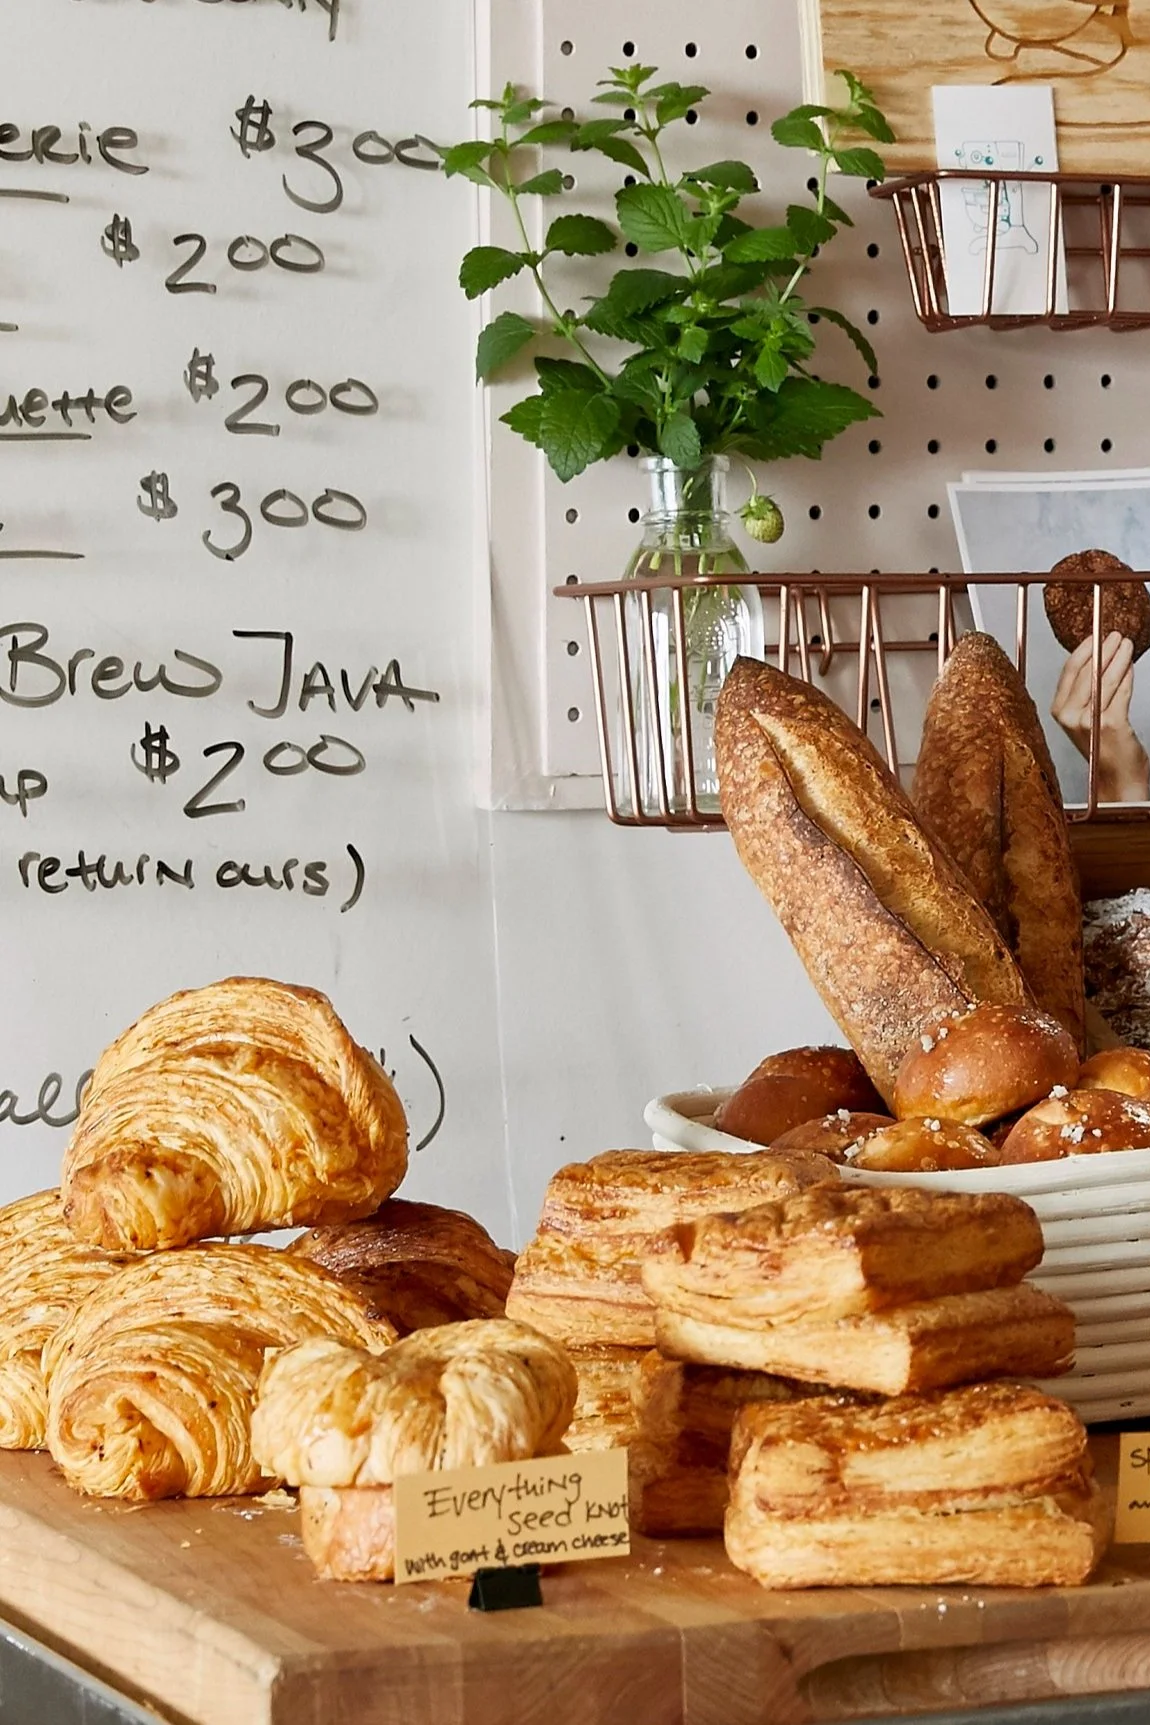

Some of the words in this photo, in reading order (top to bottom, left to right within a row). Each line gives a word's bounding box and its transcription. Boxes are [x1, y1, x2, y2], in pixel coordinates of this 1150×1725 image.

[0, 622, 223, 708] Brew
[232, 630, 440, 719] JAVA
[494, 1538, 508, 1566] &
